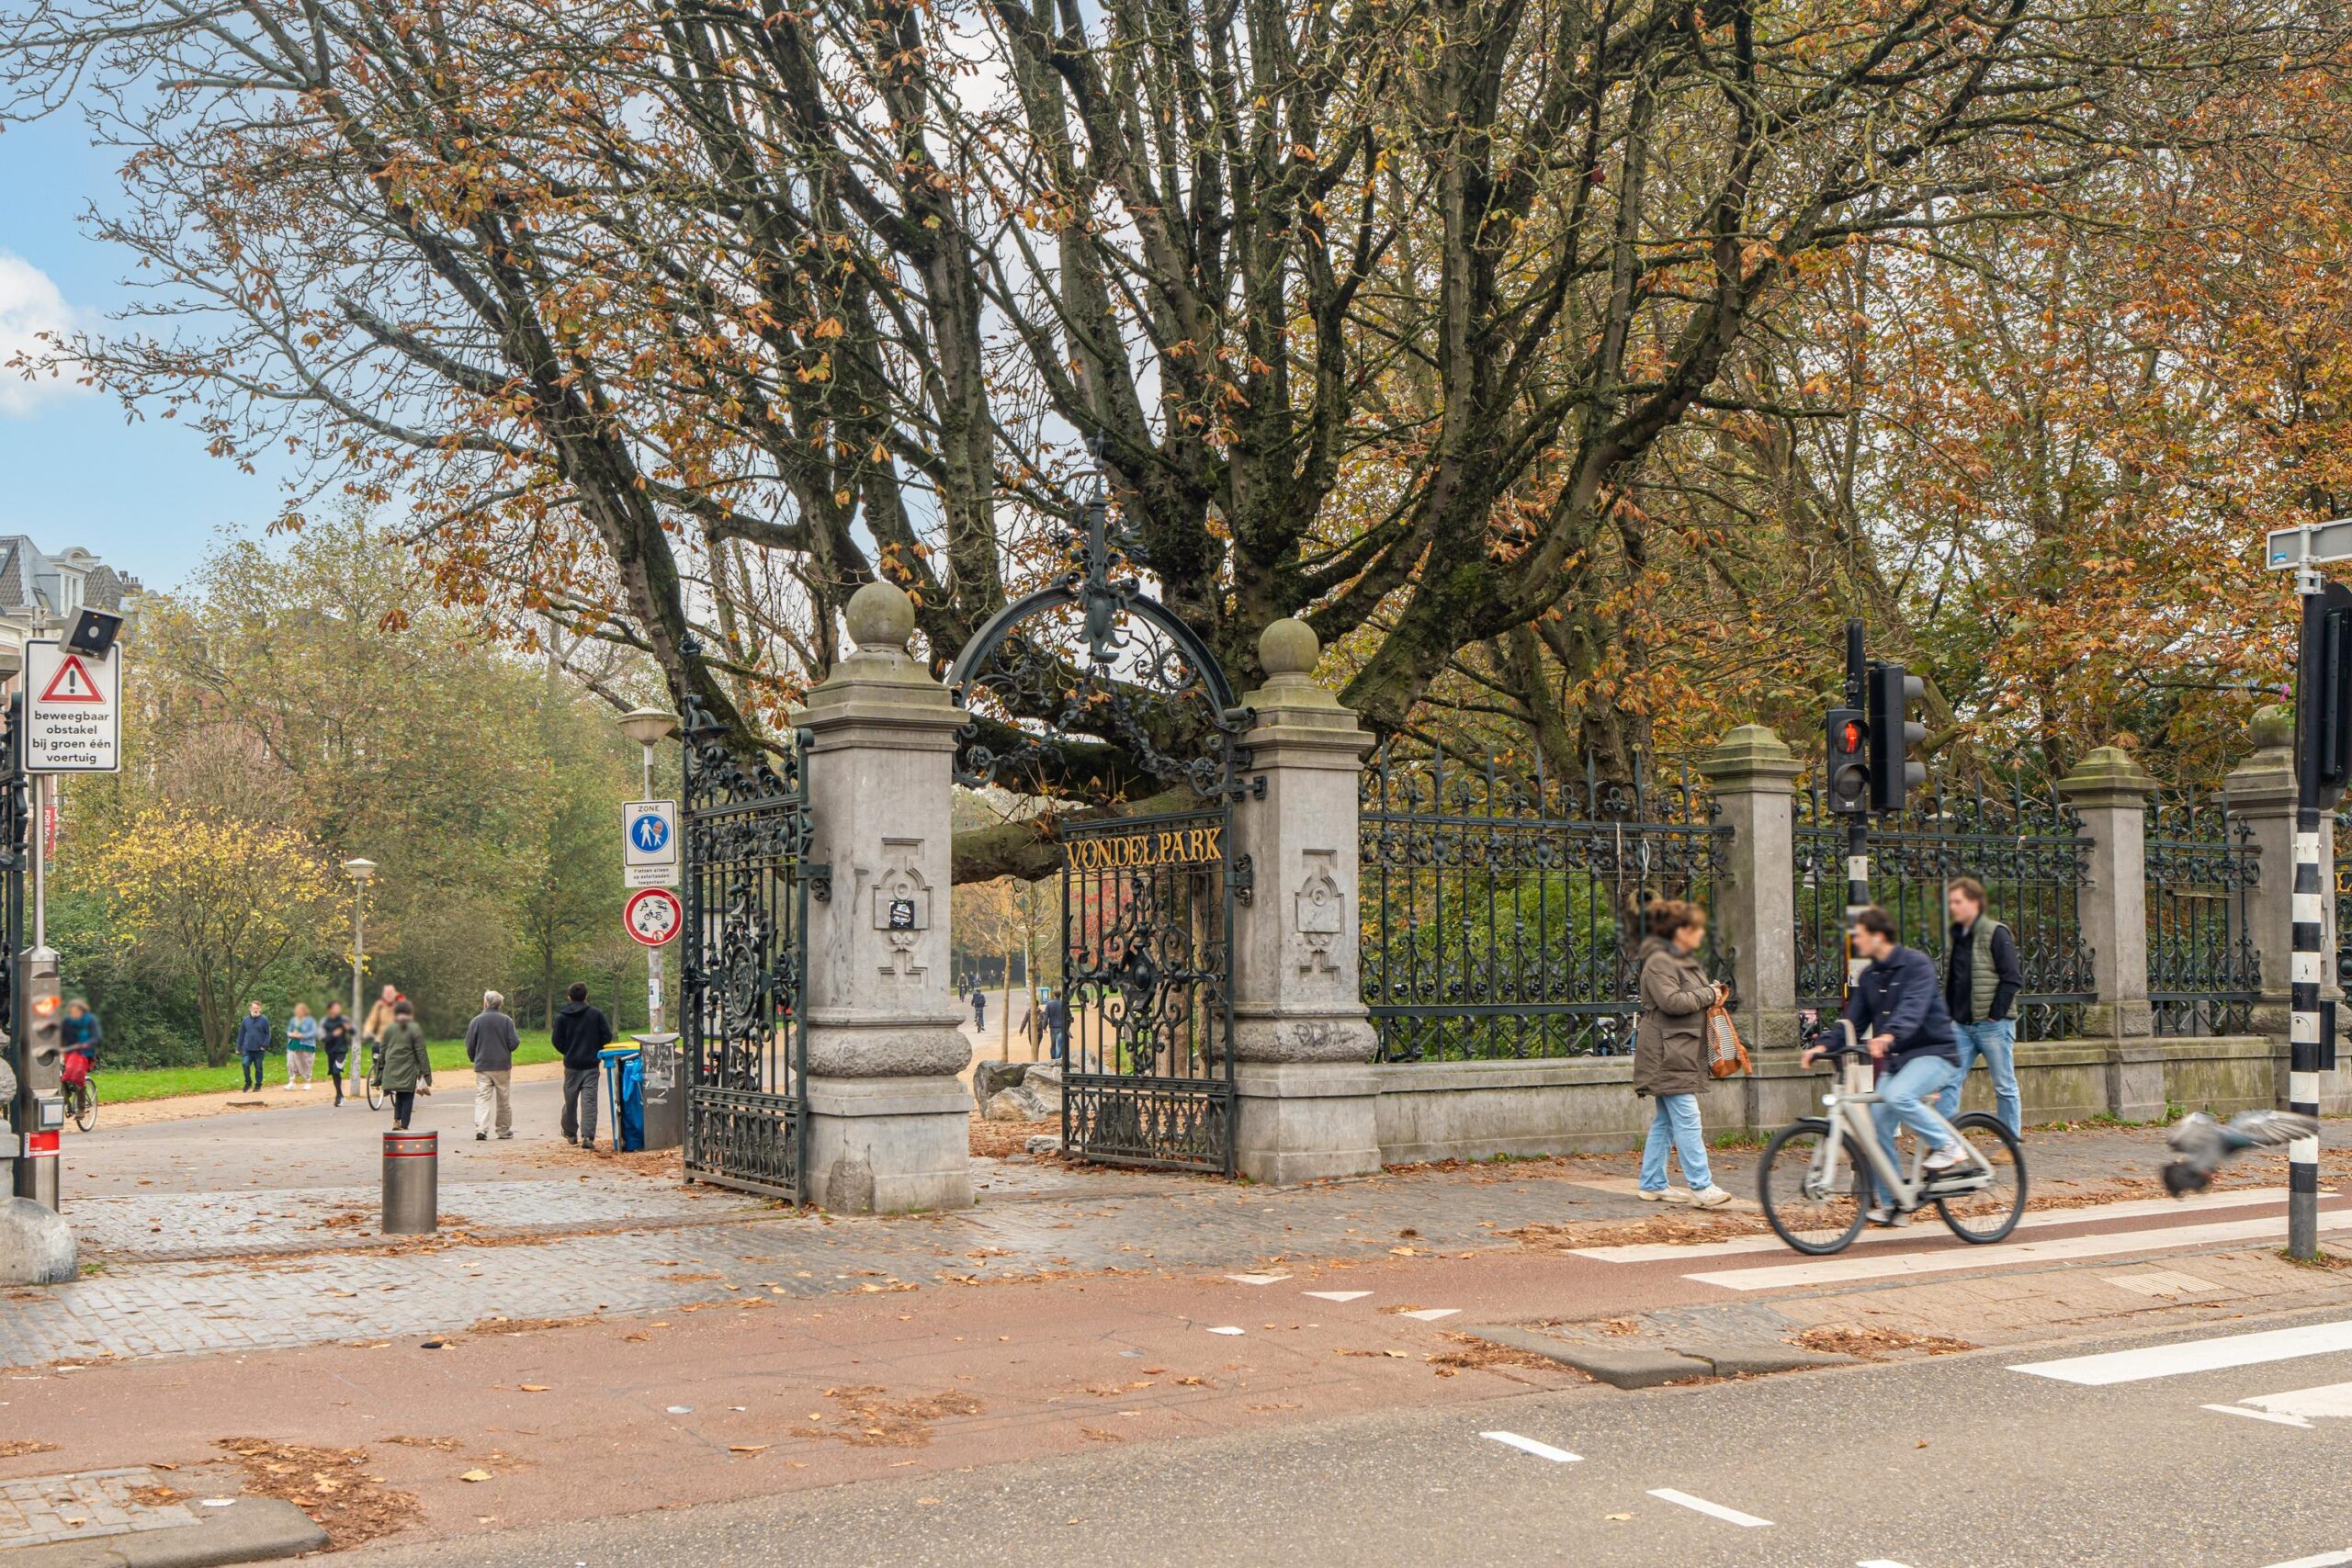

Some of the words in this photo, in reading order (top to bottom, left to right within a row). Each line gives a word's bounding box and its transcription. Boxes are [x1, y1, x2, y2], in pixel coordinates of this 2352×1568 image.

[35, 710, 109, 723] beweegbaar
[46, 725, 97, 734] obstakel
[32, 738, 47, 750] bij
[51, 740, 85, 750] groen
[90, 739, 111, 749] één
[46, 753, 96, 764] voertuig
